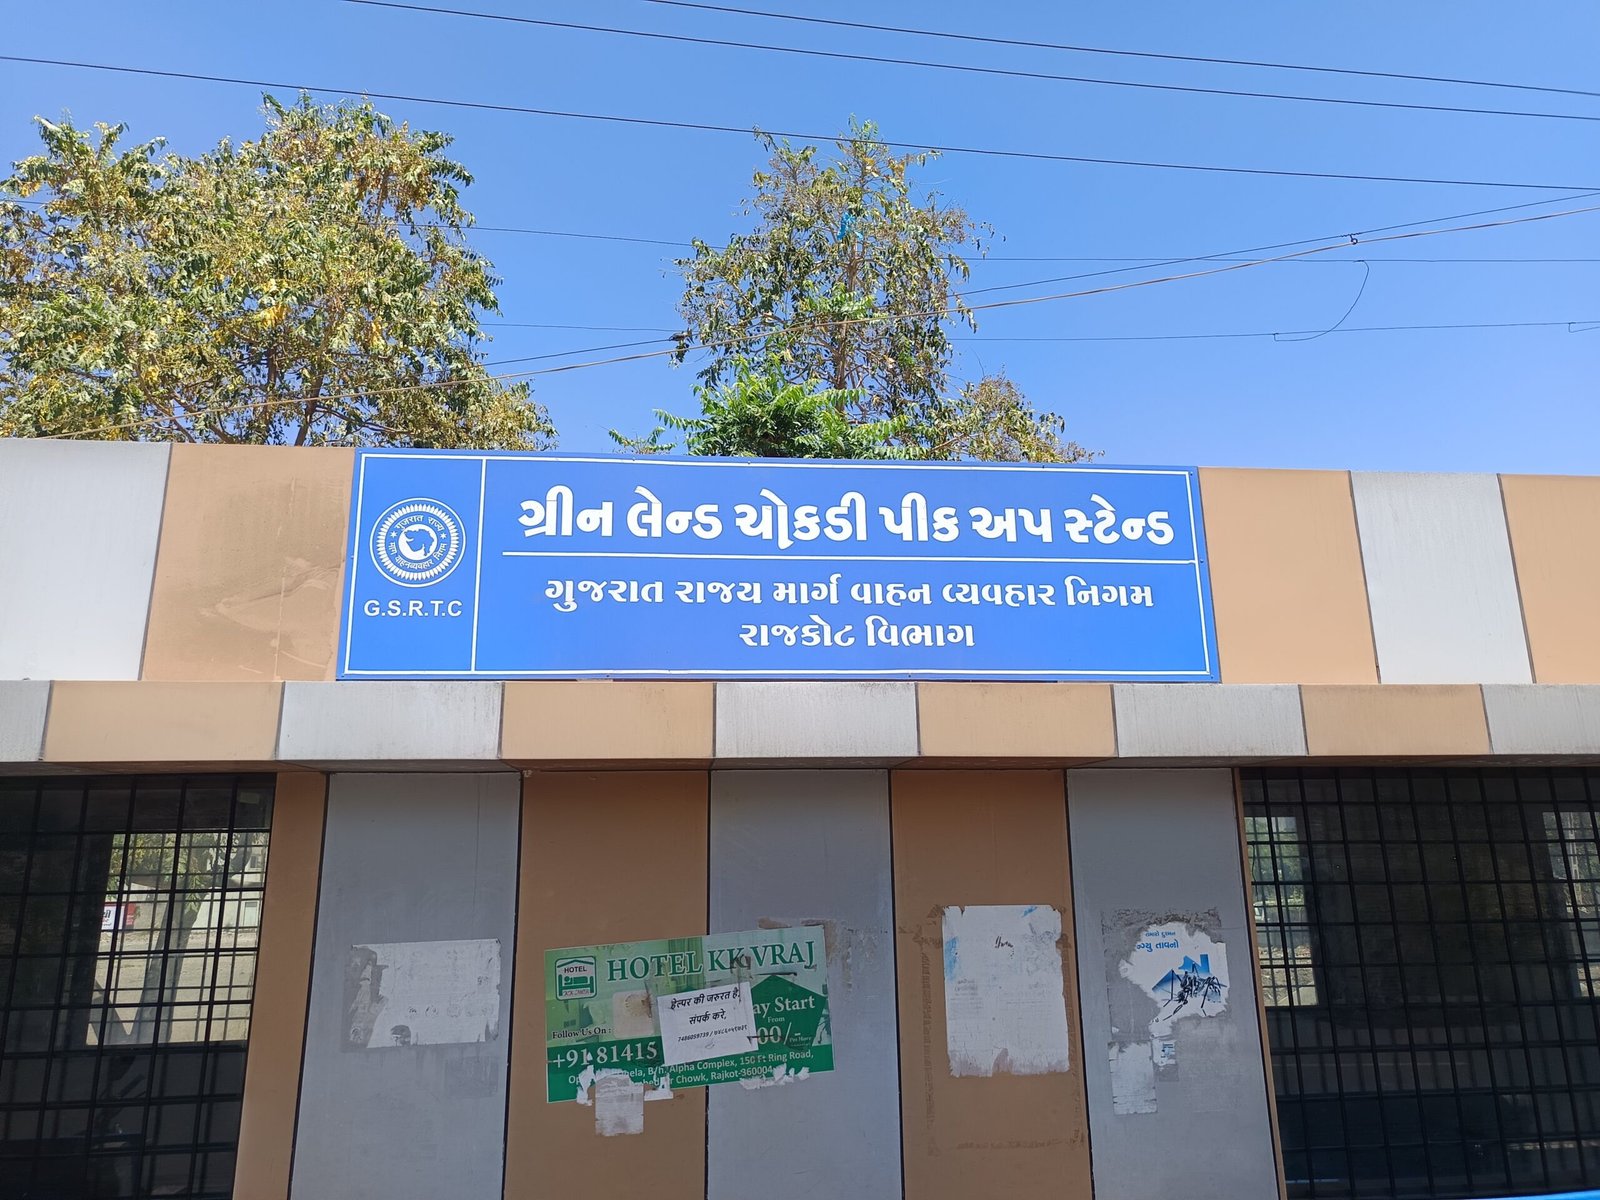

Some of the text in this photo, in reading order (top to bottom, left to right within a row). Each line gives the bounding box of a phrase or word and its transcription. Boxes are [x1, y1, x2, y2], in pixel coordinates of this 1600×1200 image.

[517, 485, 1175, 550] ગ્રીન લેન્ડ ચોકડી પીક અપ સ્ટેન્ડ
[544, 580, 664, 612] ગુજરાત
[773, 574, 842, 604] માર્ગ
[850, 583, 933, 606] વાહન
[942, 584, 1056, 607] વ્યવહાર
[1064, 576, 1154, 607] નિગમ
[364, 599, 462, 617] G.S.R.T.C
[739, 614, 976, 647] રાજકોટ વિભાગ
[563, 965, 588, 974] HOTEL
[607, 951, 703, 982] HOTEL
[750, 941, 815, 970] VRAJ
[693, 993, 705, 1005] की
[753, 995, 815, 1018] ay Start
[552, 1029, 580, 1039] Follow
[581, 1027, 592, 1036] Us
[593, 1026, 607, 1035] On
[552, 1041, 658, 1069] +91 81415
[669, 1061, 695, 1073] Alpha
[696, 1058, 738, 1070] Complex,
[740, 1056, 756, 1066] 150
[768, 1052, 787, 1063] Ring
[789, 1050, 814, 1060] Road,
[675, 1072, 709, 1084] Chowk,
[710, 1066, 773, 1081] Rajkot-360004
